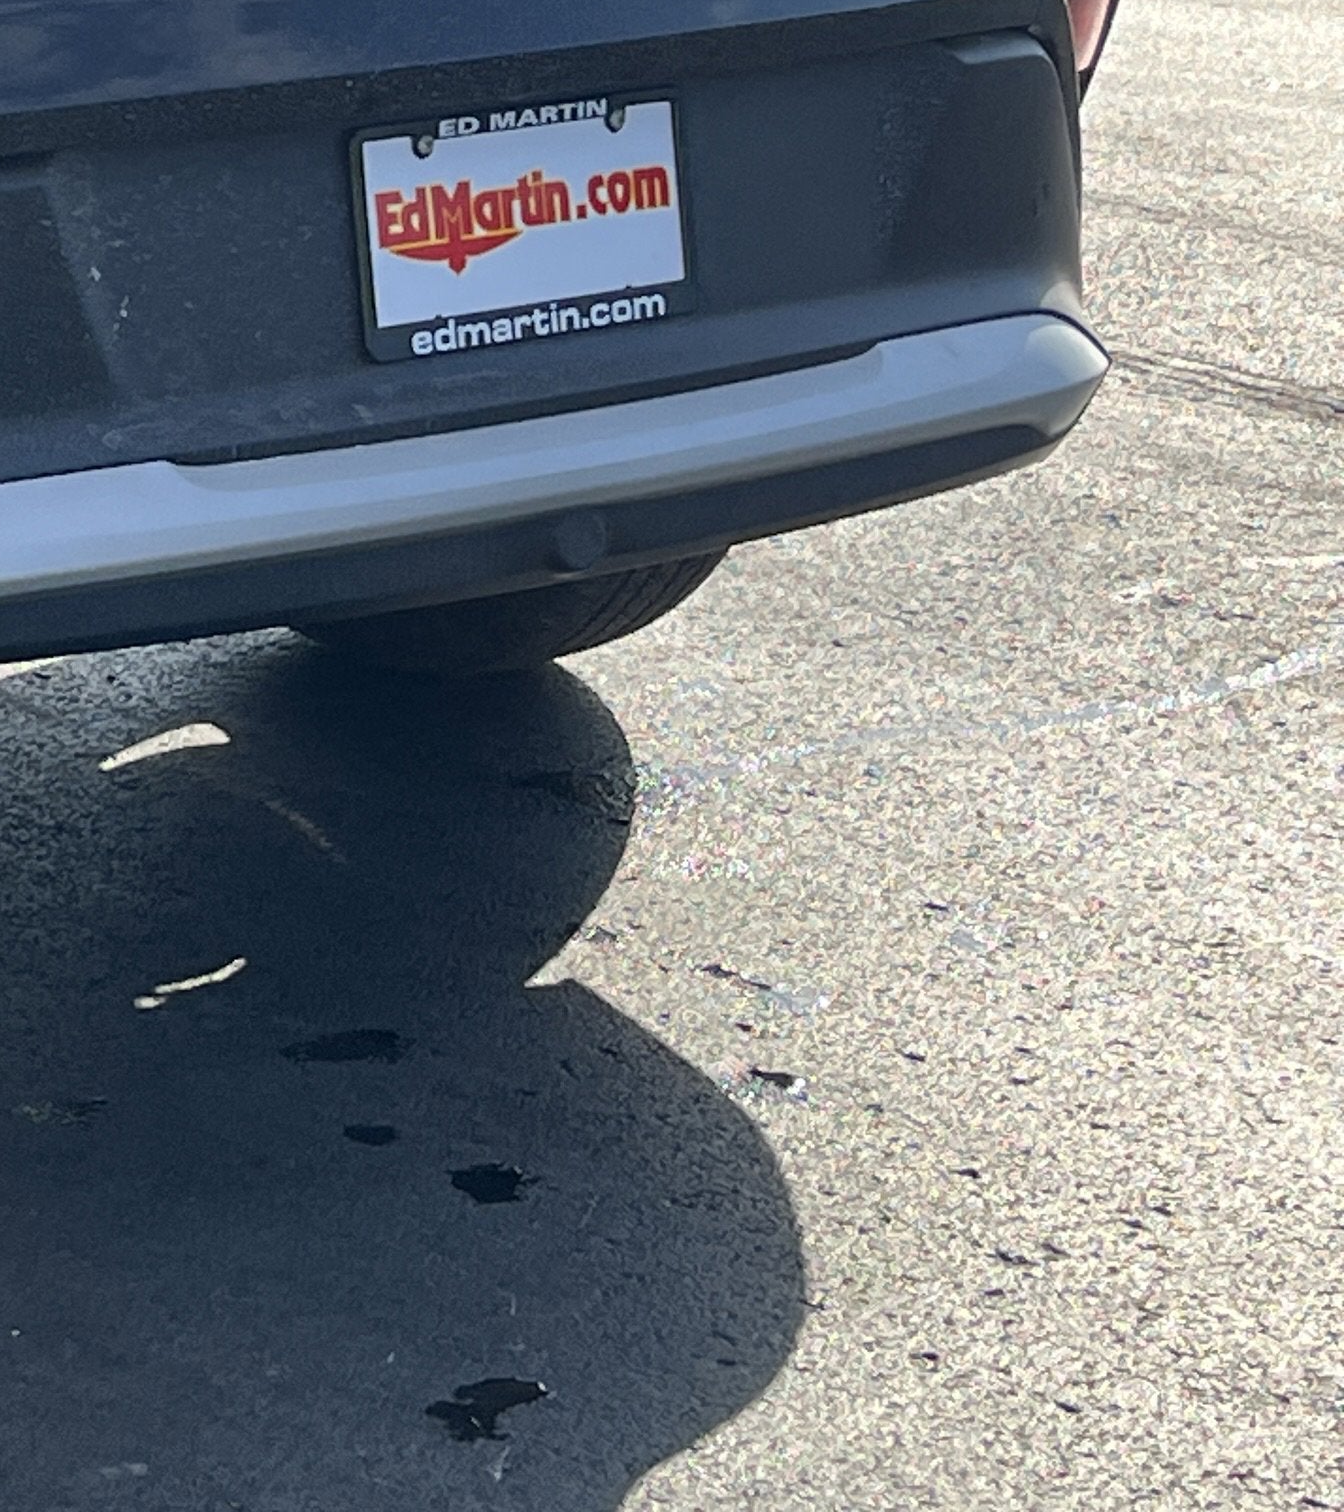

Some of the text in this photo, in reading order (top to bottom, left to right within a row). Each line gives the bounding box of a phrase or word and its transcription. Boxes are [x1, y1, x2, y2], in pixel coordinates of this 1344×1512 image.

[438, 98, 609, 138] ED MARTIN
[374, 165, 671, 250] EdMartin.com
[410, 292, 666, 357] edmartin.com
